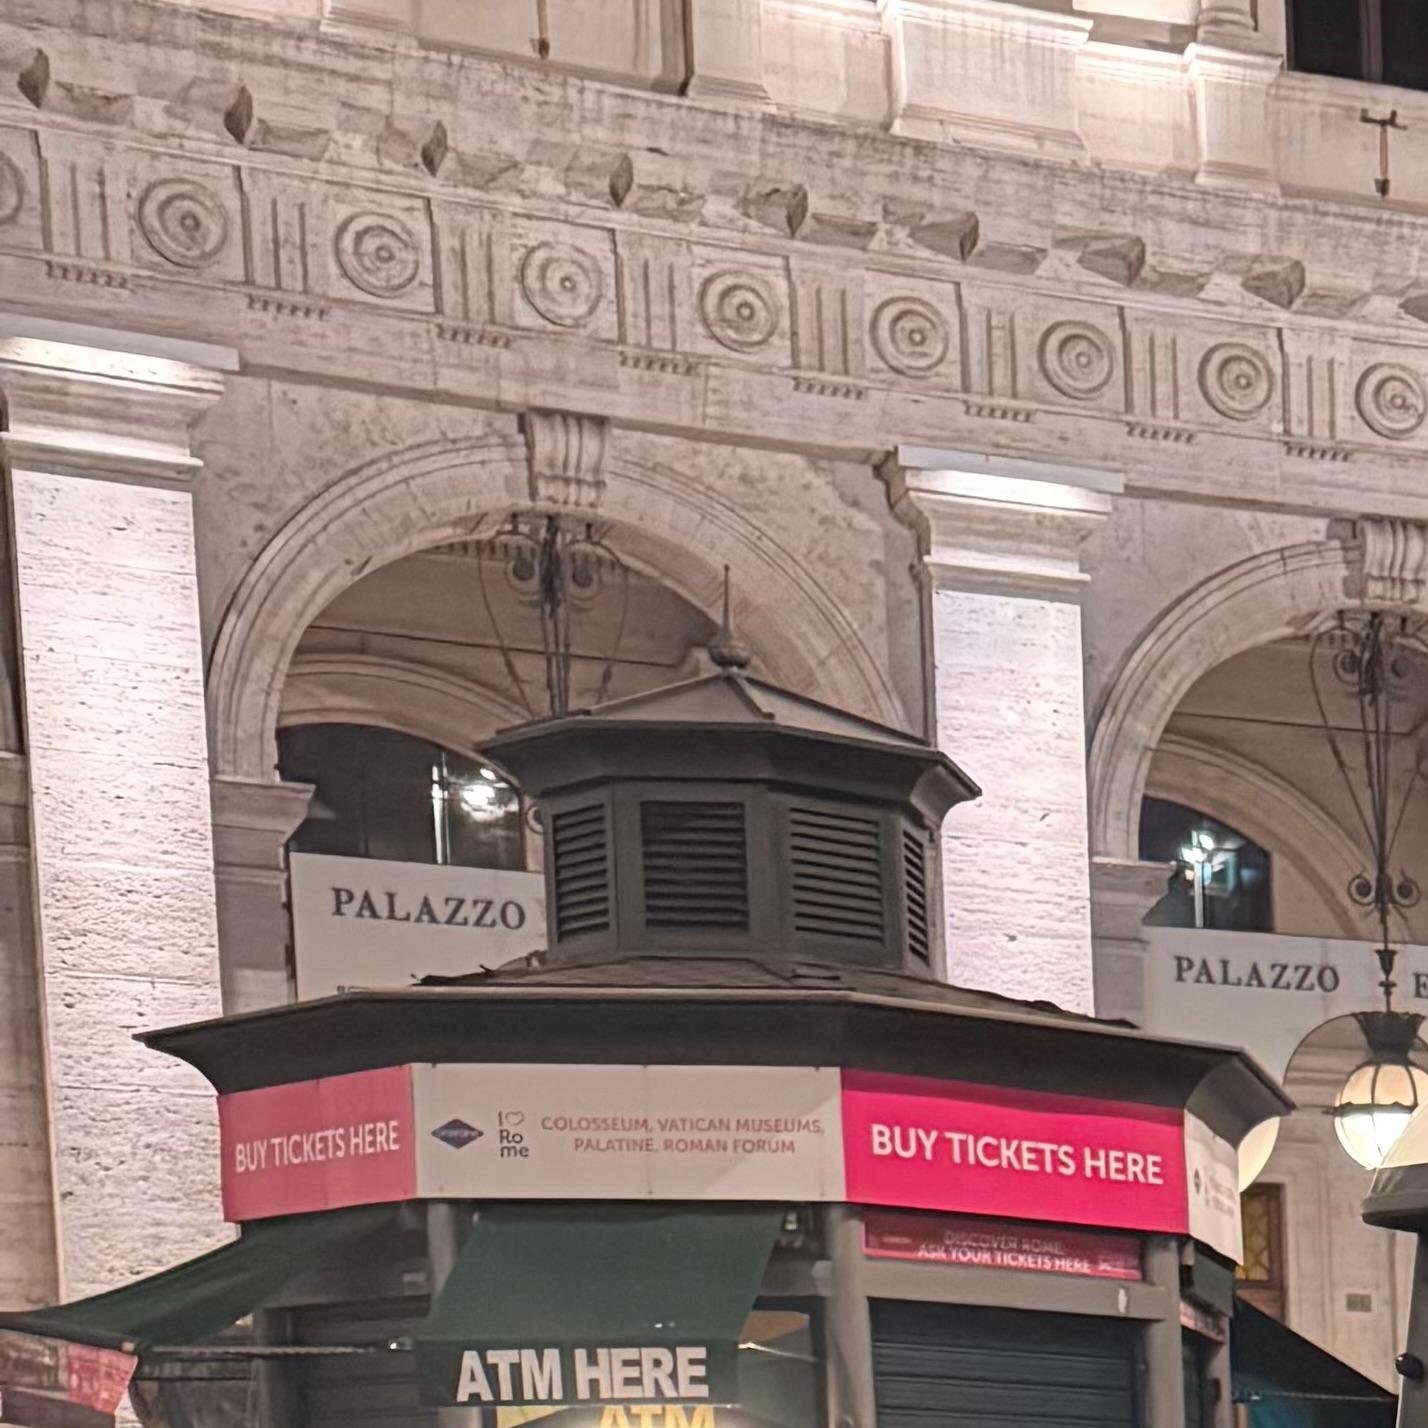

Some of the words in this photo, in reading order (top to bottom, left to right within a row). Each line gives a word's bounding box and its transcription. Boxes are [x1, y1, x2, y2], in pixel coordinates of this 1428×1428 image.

[331, 887, 525, 930] PALAZZO
[1173, 955, 1341, 994] PALAZZO
[541, 1116, 653, 1134] COLOSSEUM,
[657, 1118, 731, 1132] VATICAN
[736, 1118, 825, 1136] MUSEUMS,
[663, 1138, 728, 1153] ROMAN
[732, 1139, 796, 1154] FORUM
[235, 1138, 268, 1174] BUY
[272, 1127, 346, 1167] TICKETS
[349, 1120, 400, 1156] HERE
[870, 1123, 938, 1161] BUY
[944, 1131, 1076, 1176] TICKETS
[1084, 1147, 1164, 1185] HERE
[949, 1246, 992, 1265] YOUR
[996, 1251, 1051, 1269] TICKETS
[1052, 1257, 1091, 1273] HERE
[456, 1348, 563, 1402] ATM
[574, 1346, 709, 1399] HERE
